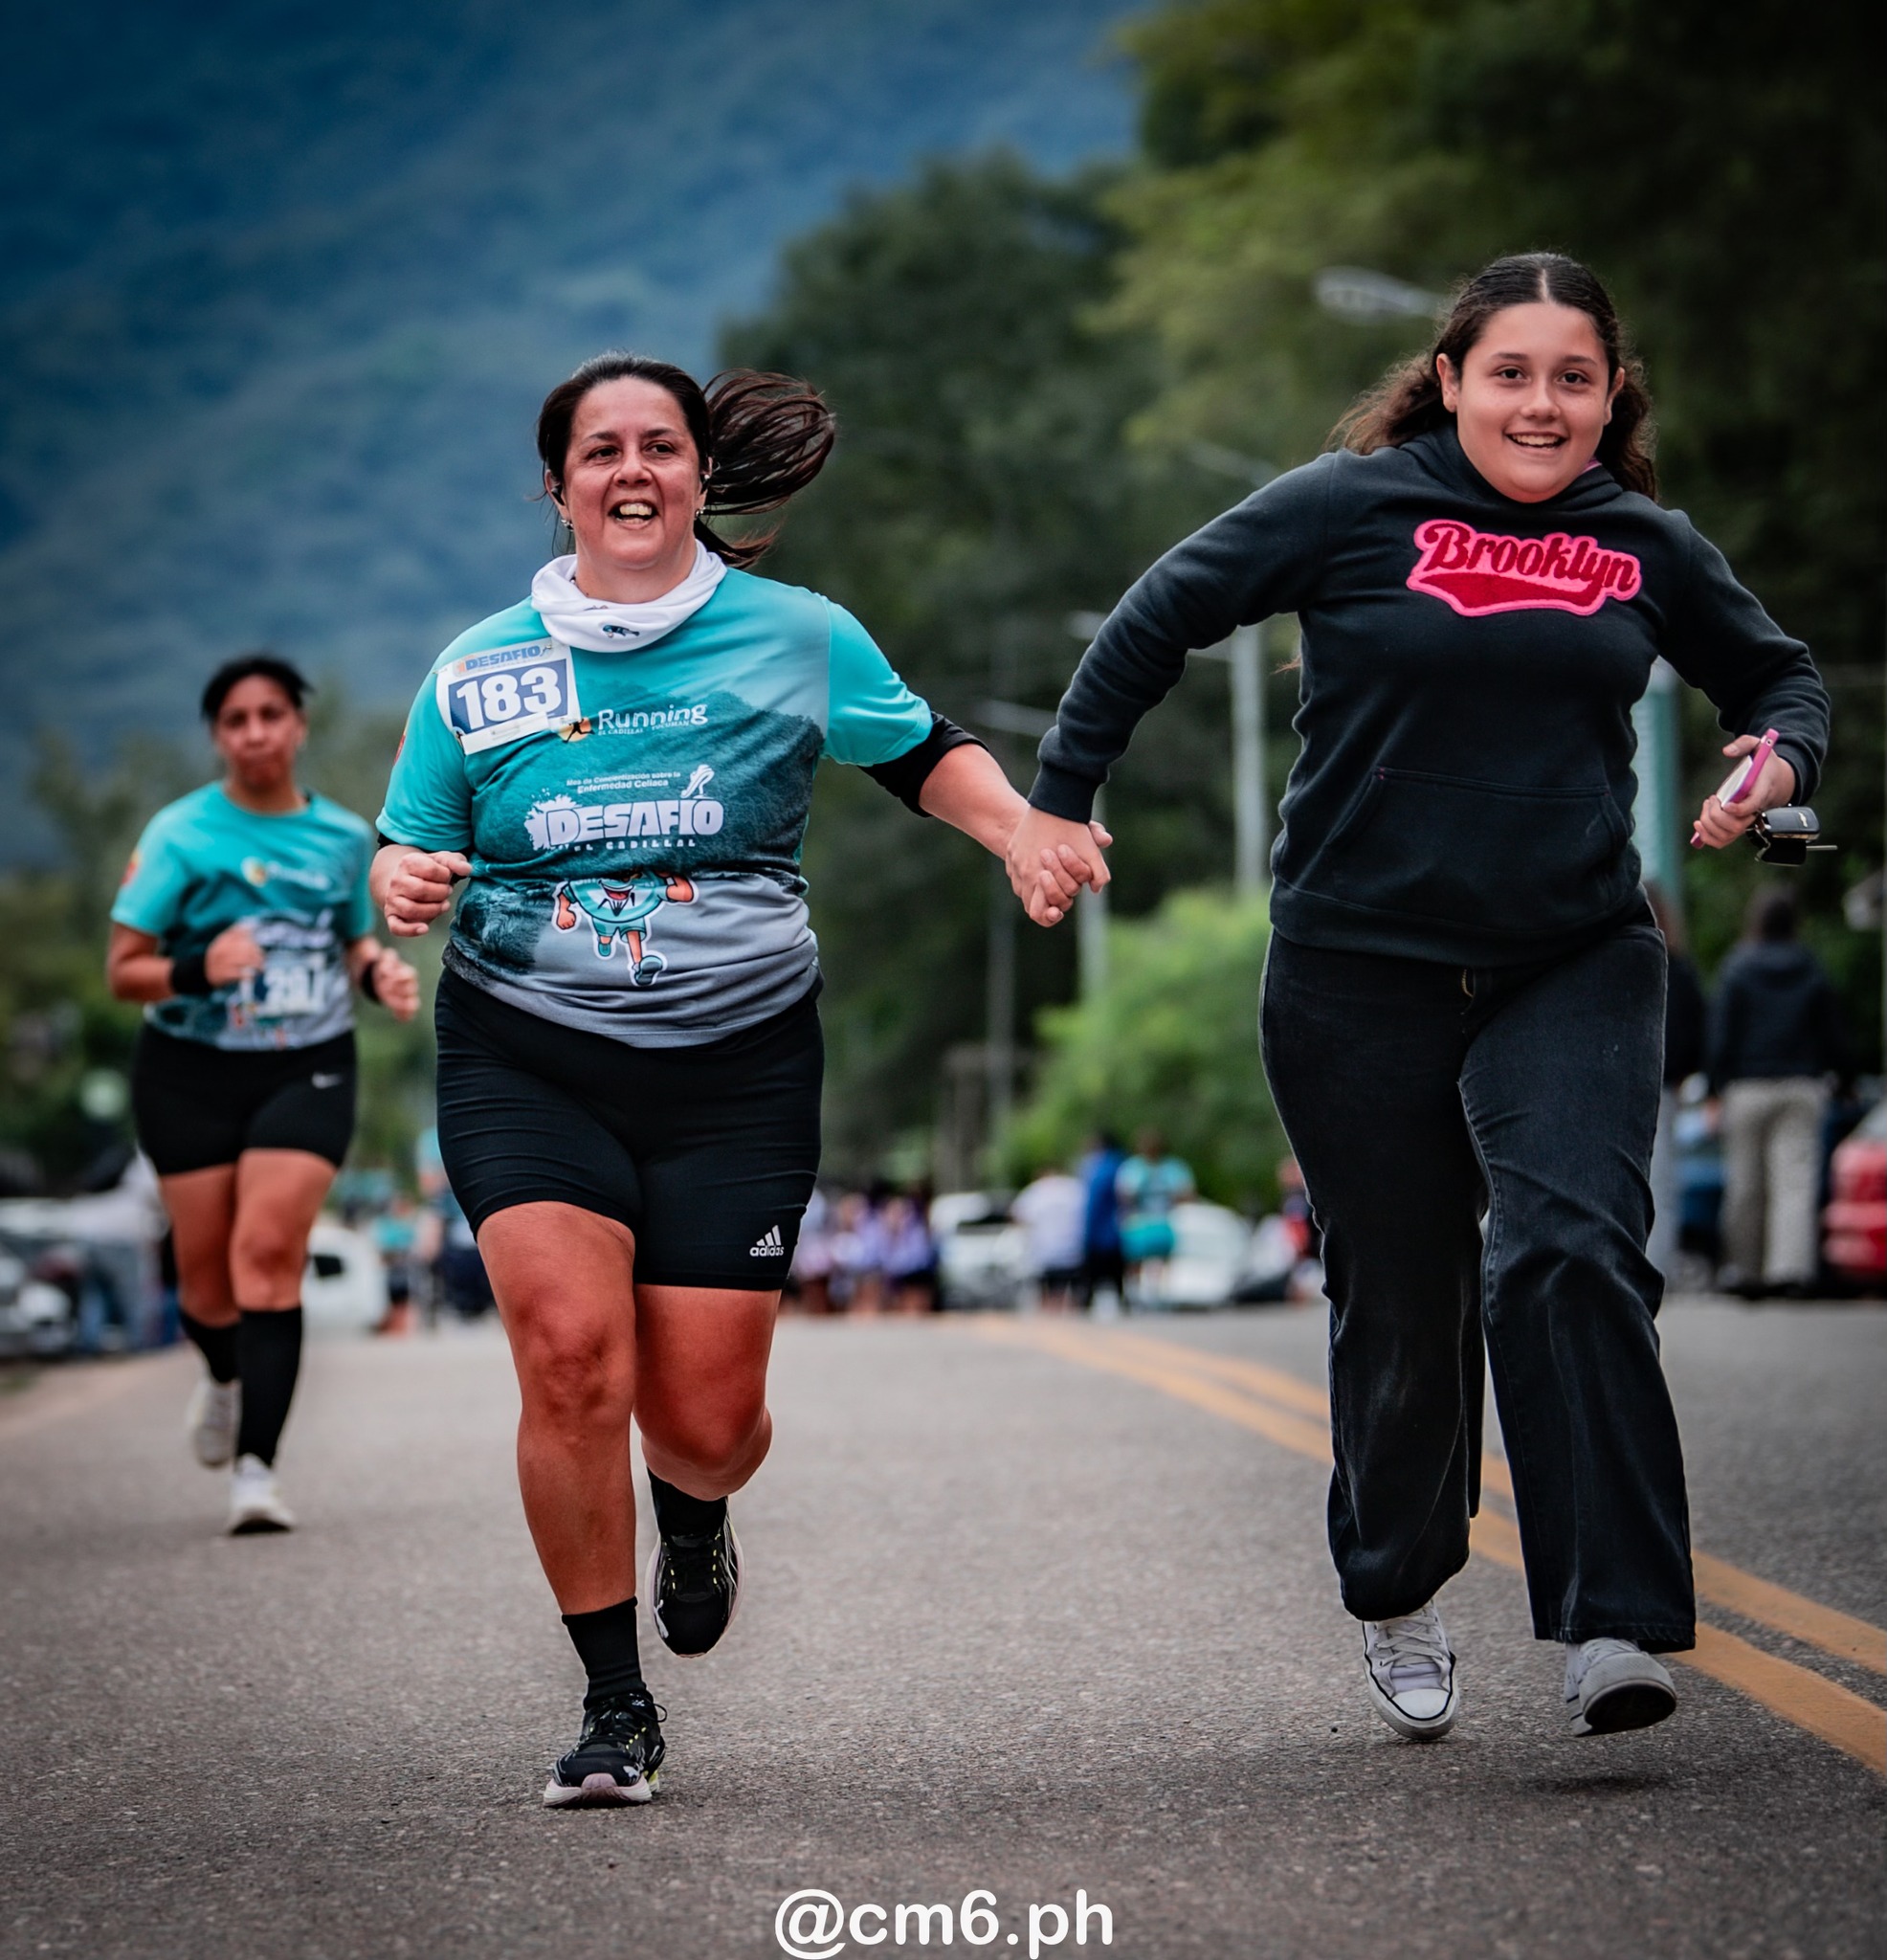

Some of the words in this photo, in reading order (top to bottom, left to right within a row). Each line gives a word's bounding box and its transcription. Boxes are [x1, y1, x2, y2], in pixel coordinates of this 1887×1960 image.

[1414, 520, 1641, 603] Brooklyn
[465, 645, 541, 670] DESAFIO
[456, 667, 562, 730] 183
[598, 704, 708, 730] Running
[577, 780, 633, 793] Enfermedad
[547, 800, 723, 845] DESAFIO
[606, 838, 697, 851] CADILLAL
